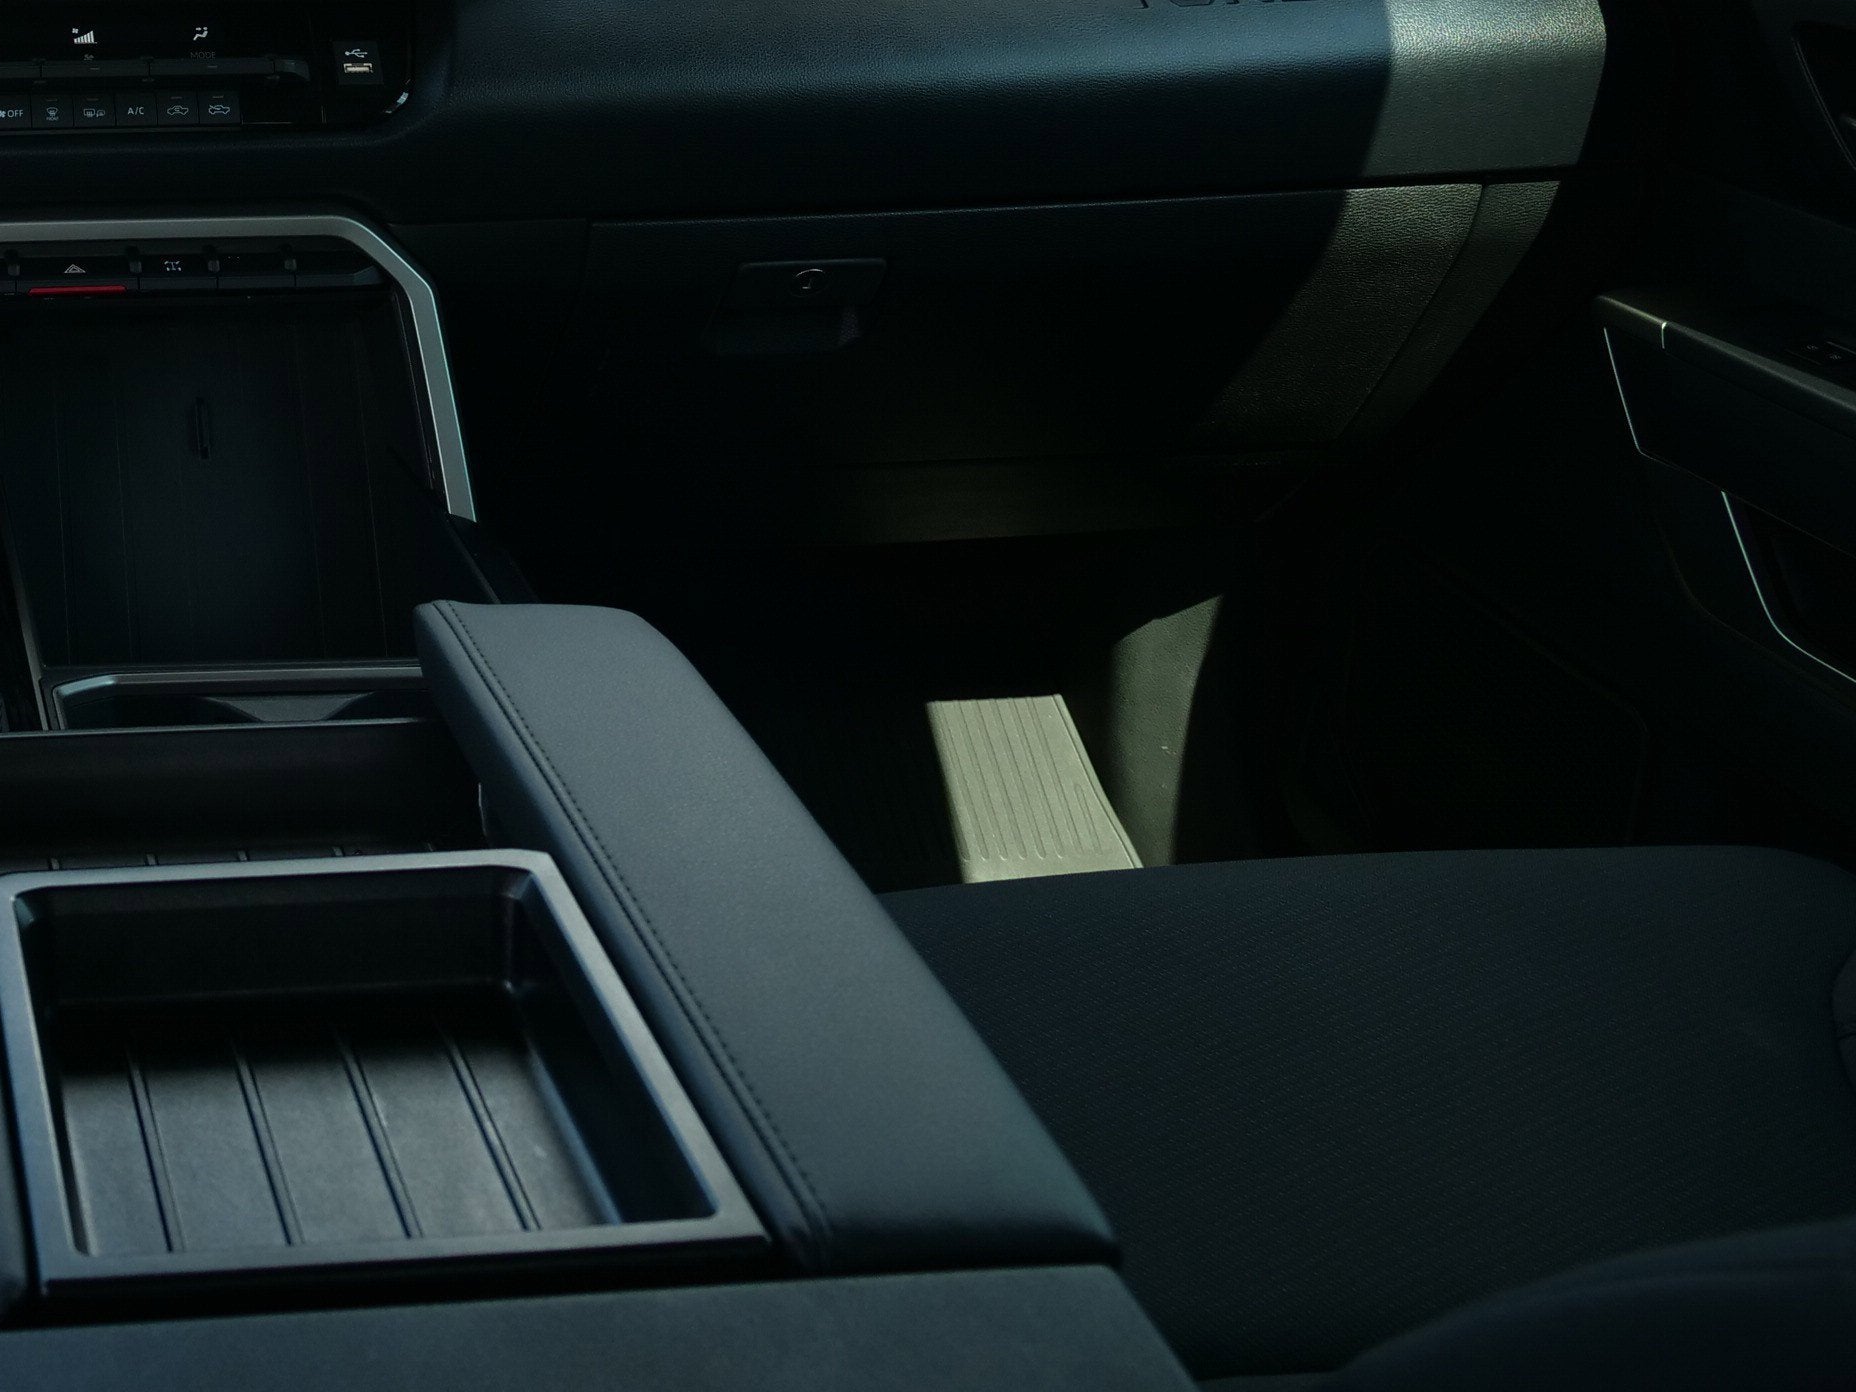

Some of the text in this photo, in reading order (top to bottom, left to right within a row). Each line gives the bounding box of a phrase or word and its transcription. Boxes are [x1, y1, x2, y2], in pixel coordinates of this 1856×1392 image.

[189, 50, 217, 60] MODE
[7, 108, 24, 118] OFF
[127, 106, 145, 116] A/C
